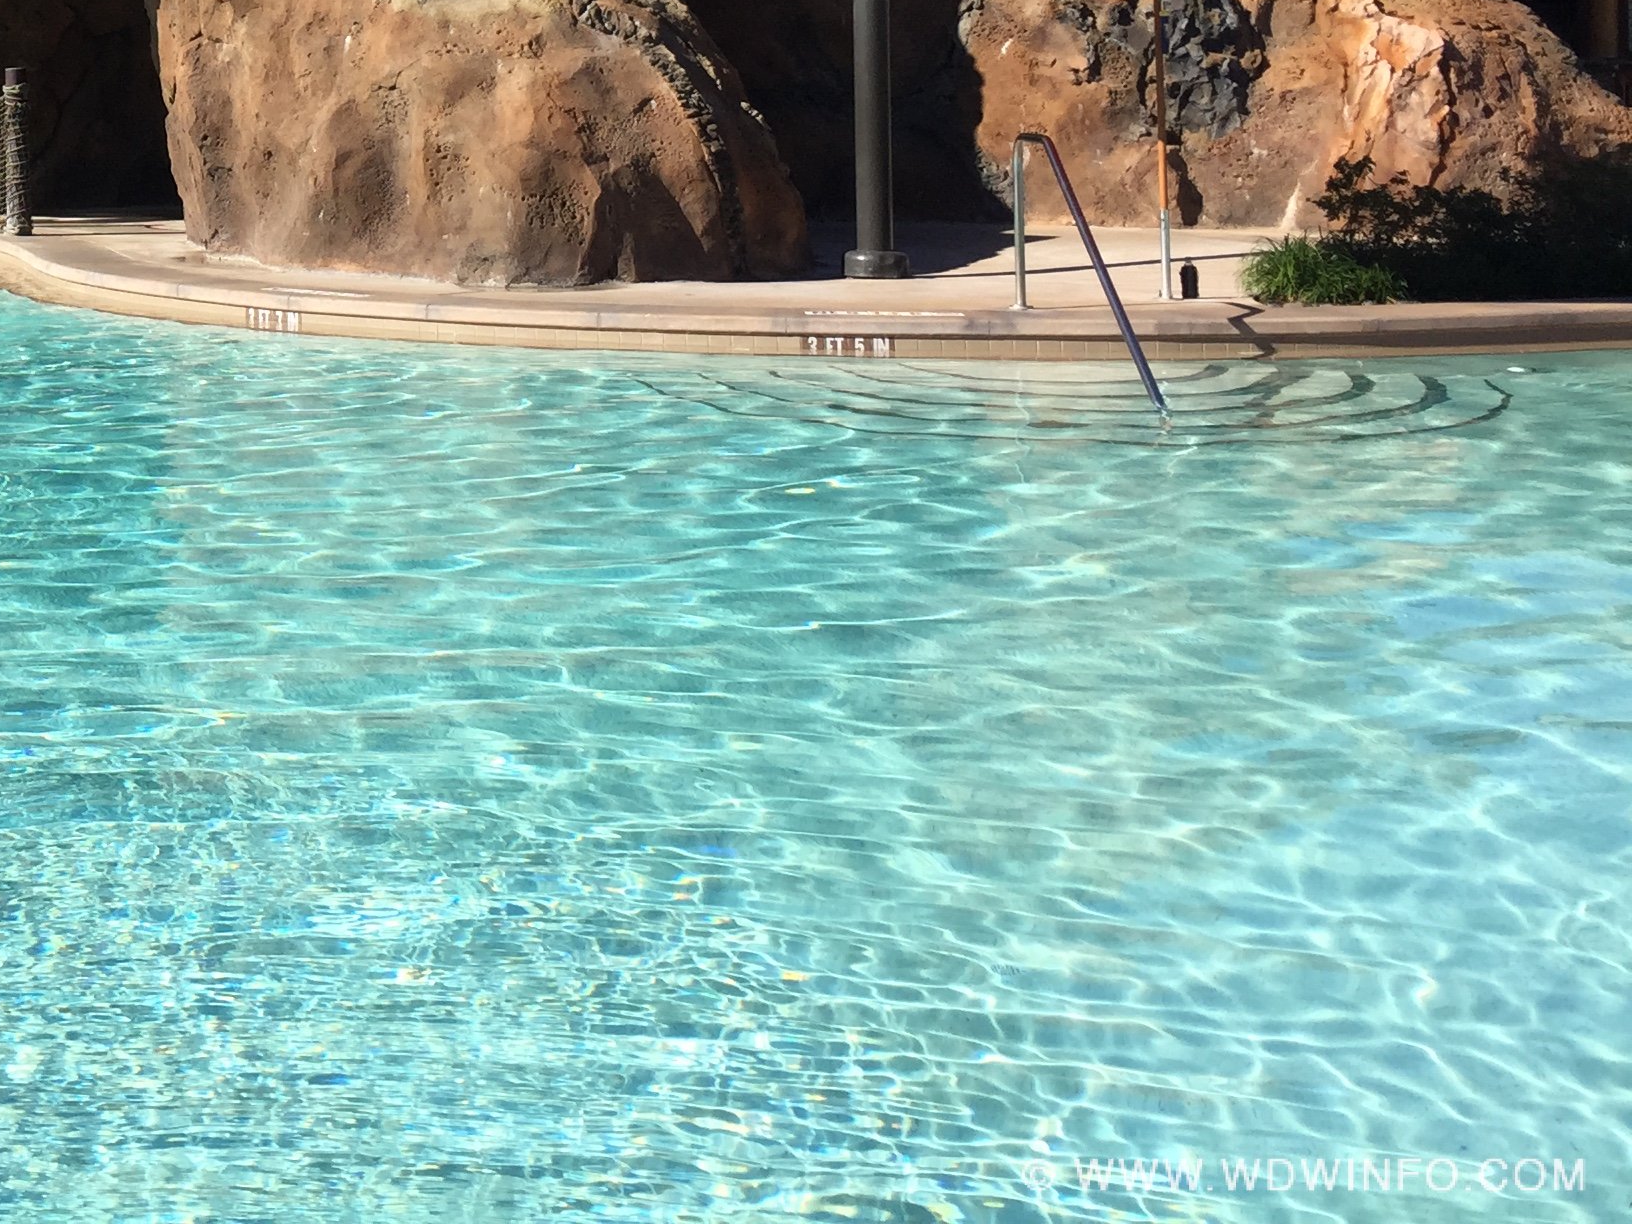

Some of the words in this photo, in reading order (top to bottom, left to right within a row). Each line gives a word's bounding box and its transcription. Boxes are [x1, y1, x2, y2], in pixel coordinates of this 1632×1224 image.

[807, 336, 818, 355] 3
[826, 337, 844, 356] FT
[854, 337, 865, 357] 5
[873, 337, 890, 358] IN
